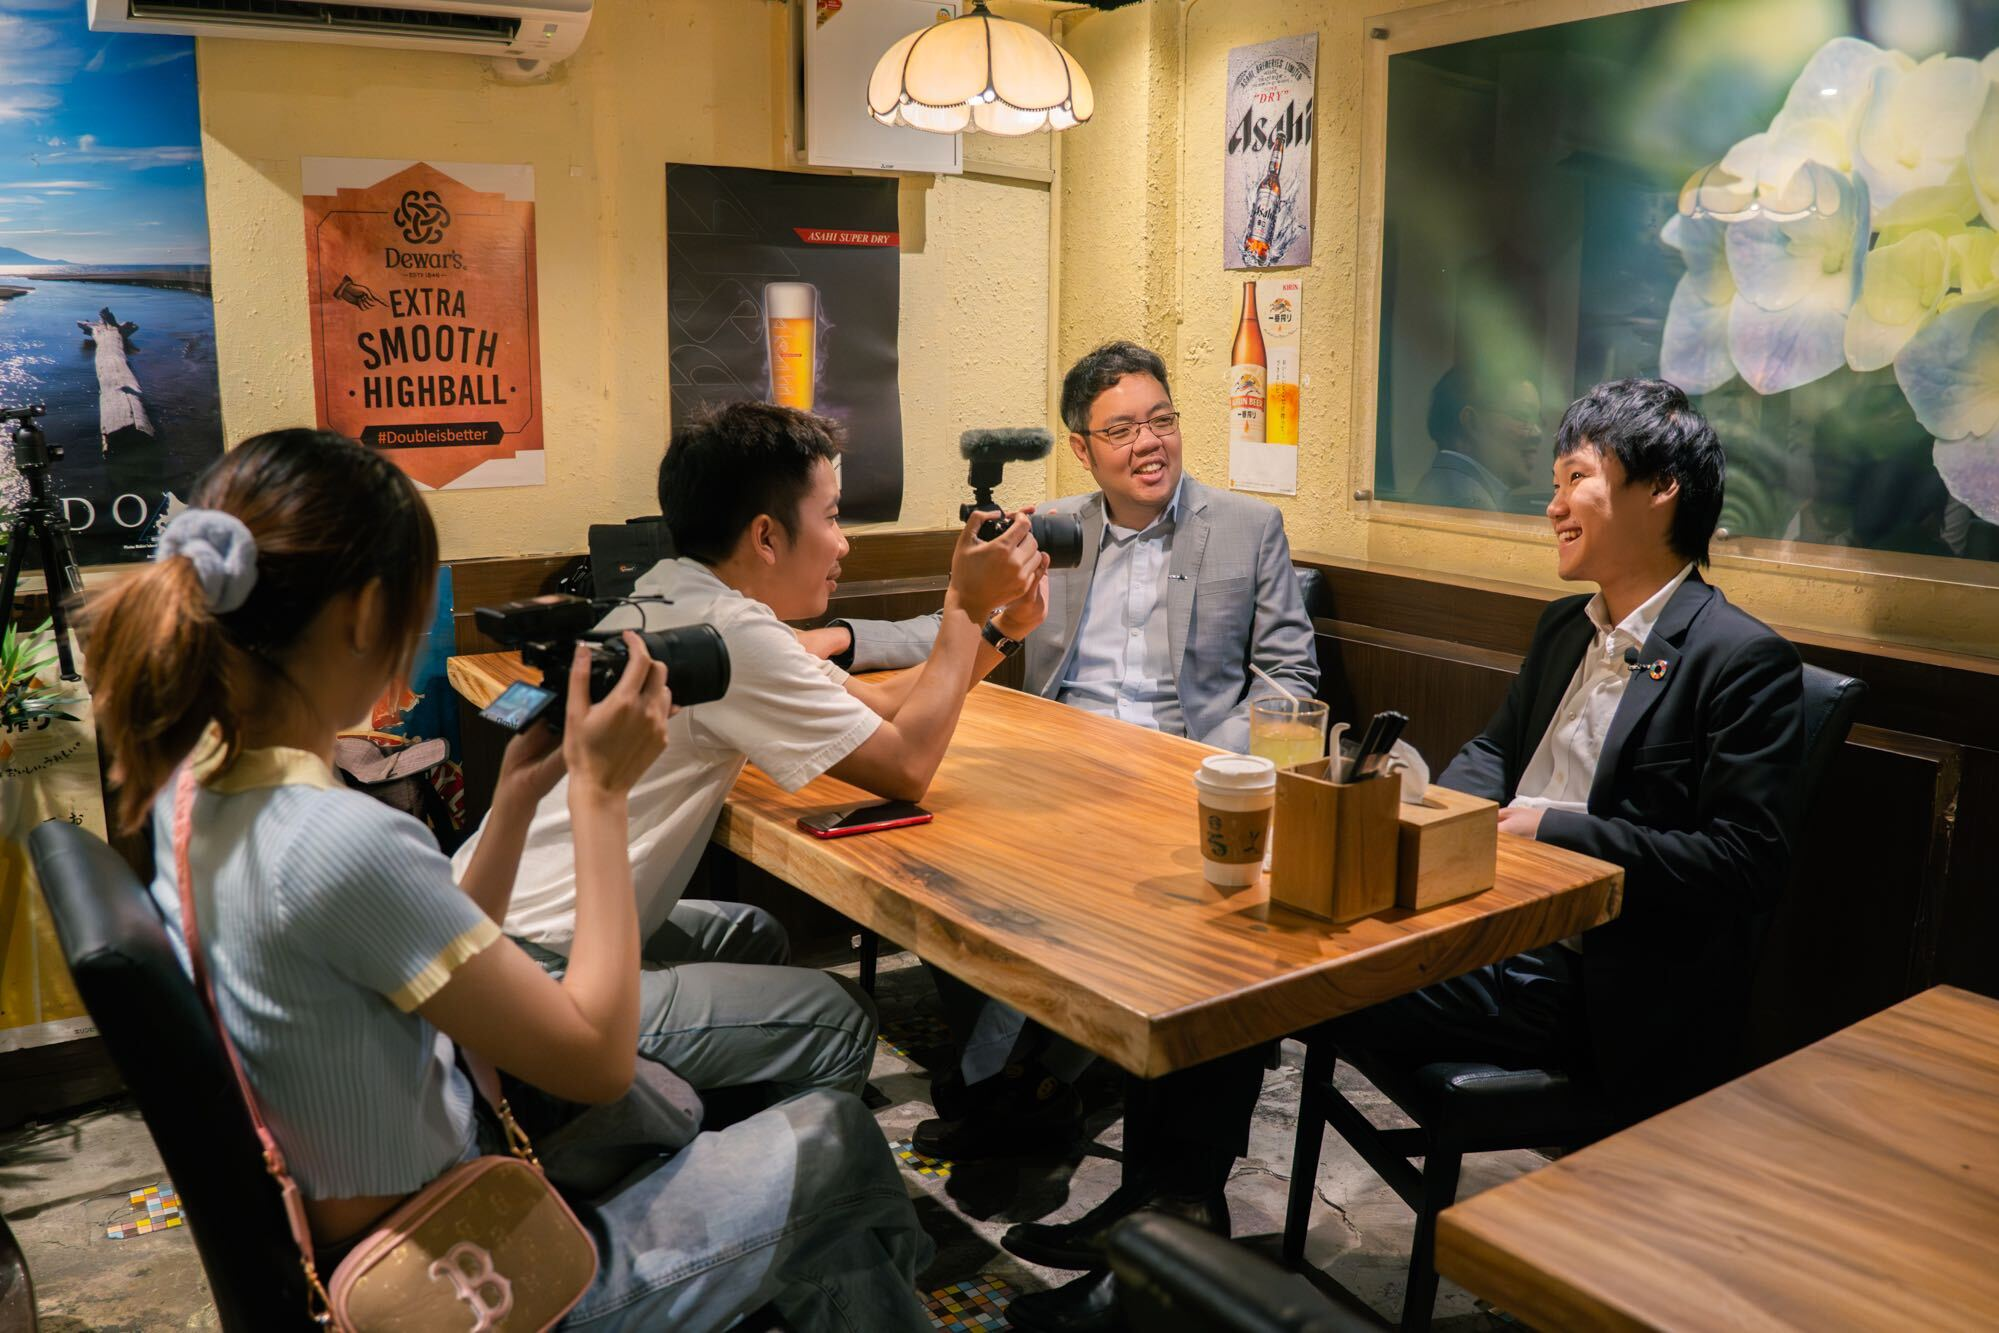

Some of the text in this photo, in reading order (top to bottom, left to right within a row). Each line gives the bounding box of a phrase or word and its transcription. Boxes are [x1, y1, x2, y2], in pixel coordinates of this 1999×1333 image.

[1228, 97, 1312, 155] Asahi
[808, 231, 891, 244] ASAHI SUPER DRY
[384, 247, 463, 270] Dewar's
[1283, 283, 1298, 291] KIRIN
[388, 288, 466, 319] EXTRA
[357, 324, 499, 370] SMOOTH
[363, 374, 508, 409] HIGHBALL
[377, 427, 489, 445] #Doubleisbetter
